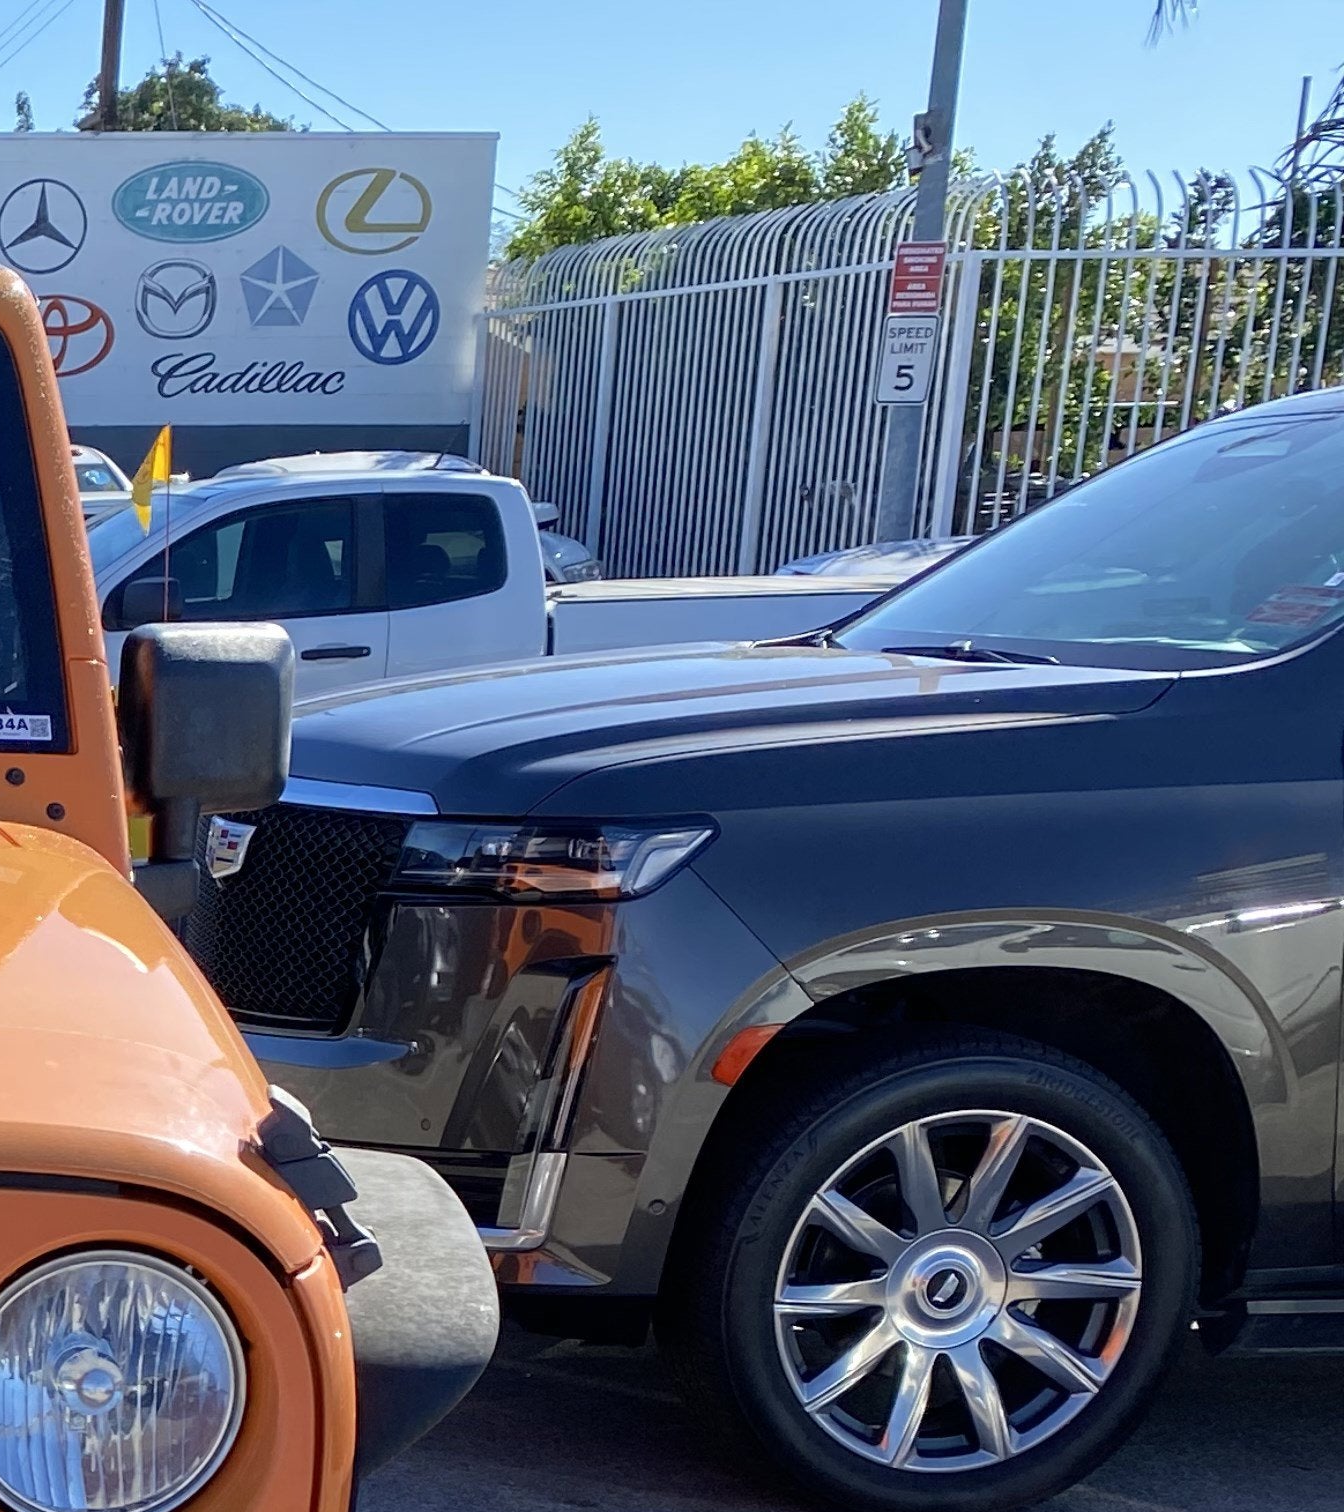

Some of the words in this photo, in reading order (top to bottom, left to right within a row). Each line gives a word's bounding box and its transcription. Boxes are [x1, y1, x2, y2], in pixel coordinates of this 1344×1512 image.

[888, 326, 934, 340] SPEED
[890, 342, 927, 355] LIMIT
[151, 352, 346, 398] Cadillac
[893, 364, 914, 391] 5
